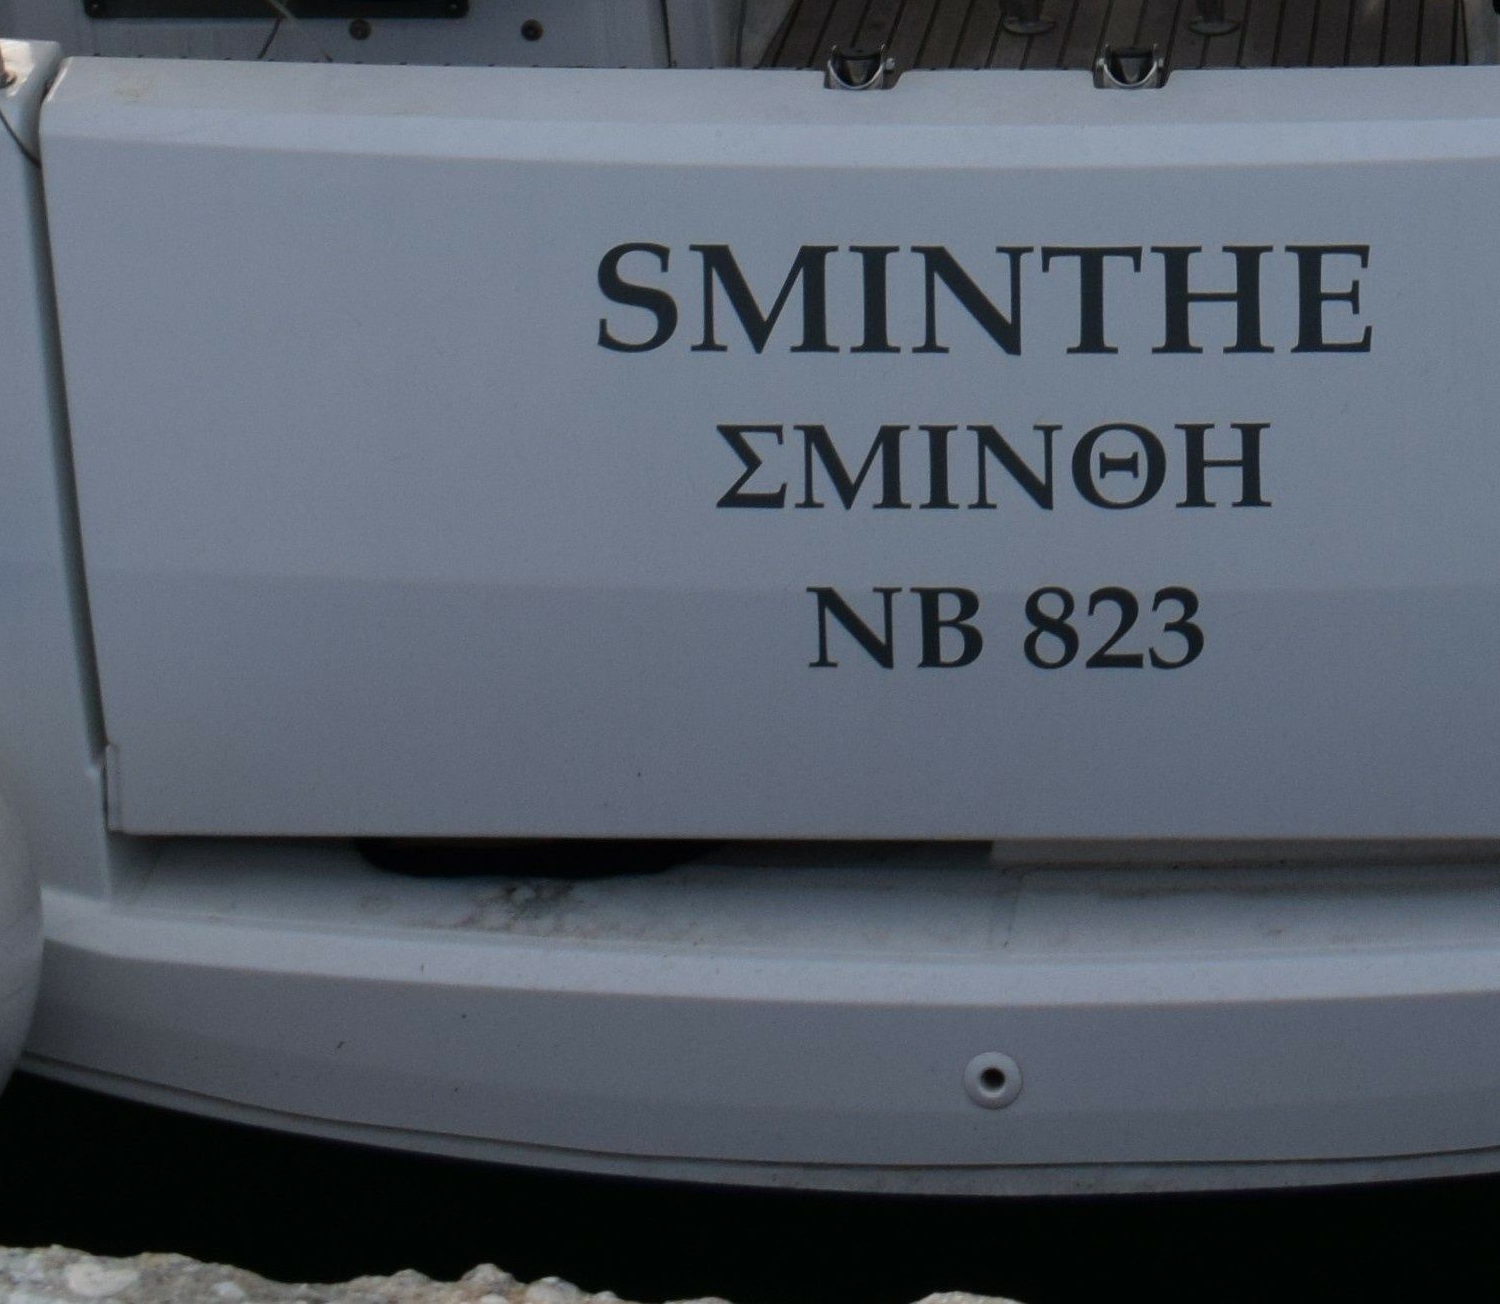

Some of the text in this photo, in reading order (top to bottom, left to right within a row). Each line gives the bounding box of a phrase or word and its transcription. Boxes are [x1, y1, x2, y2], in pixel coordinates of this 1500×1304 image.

[596, 241, 1373, 357] SMINTHE
[715, 422, 1273, 510] ΣΜΙΝΘΗ
[805, 585, 1205, 670] NB 823
